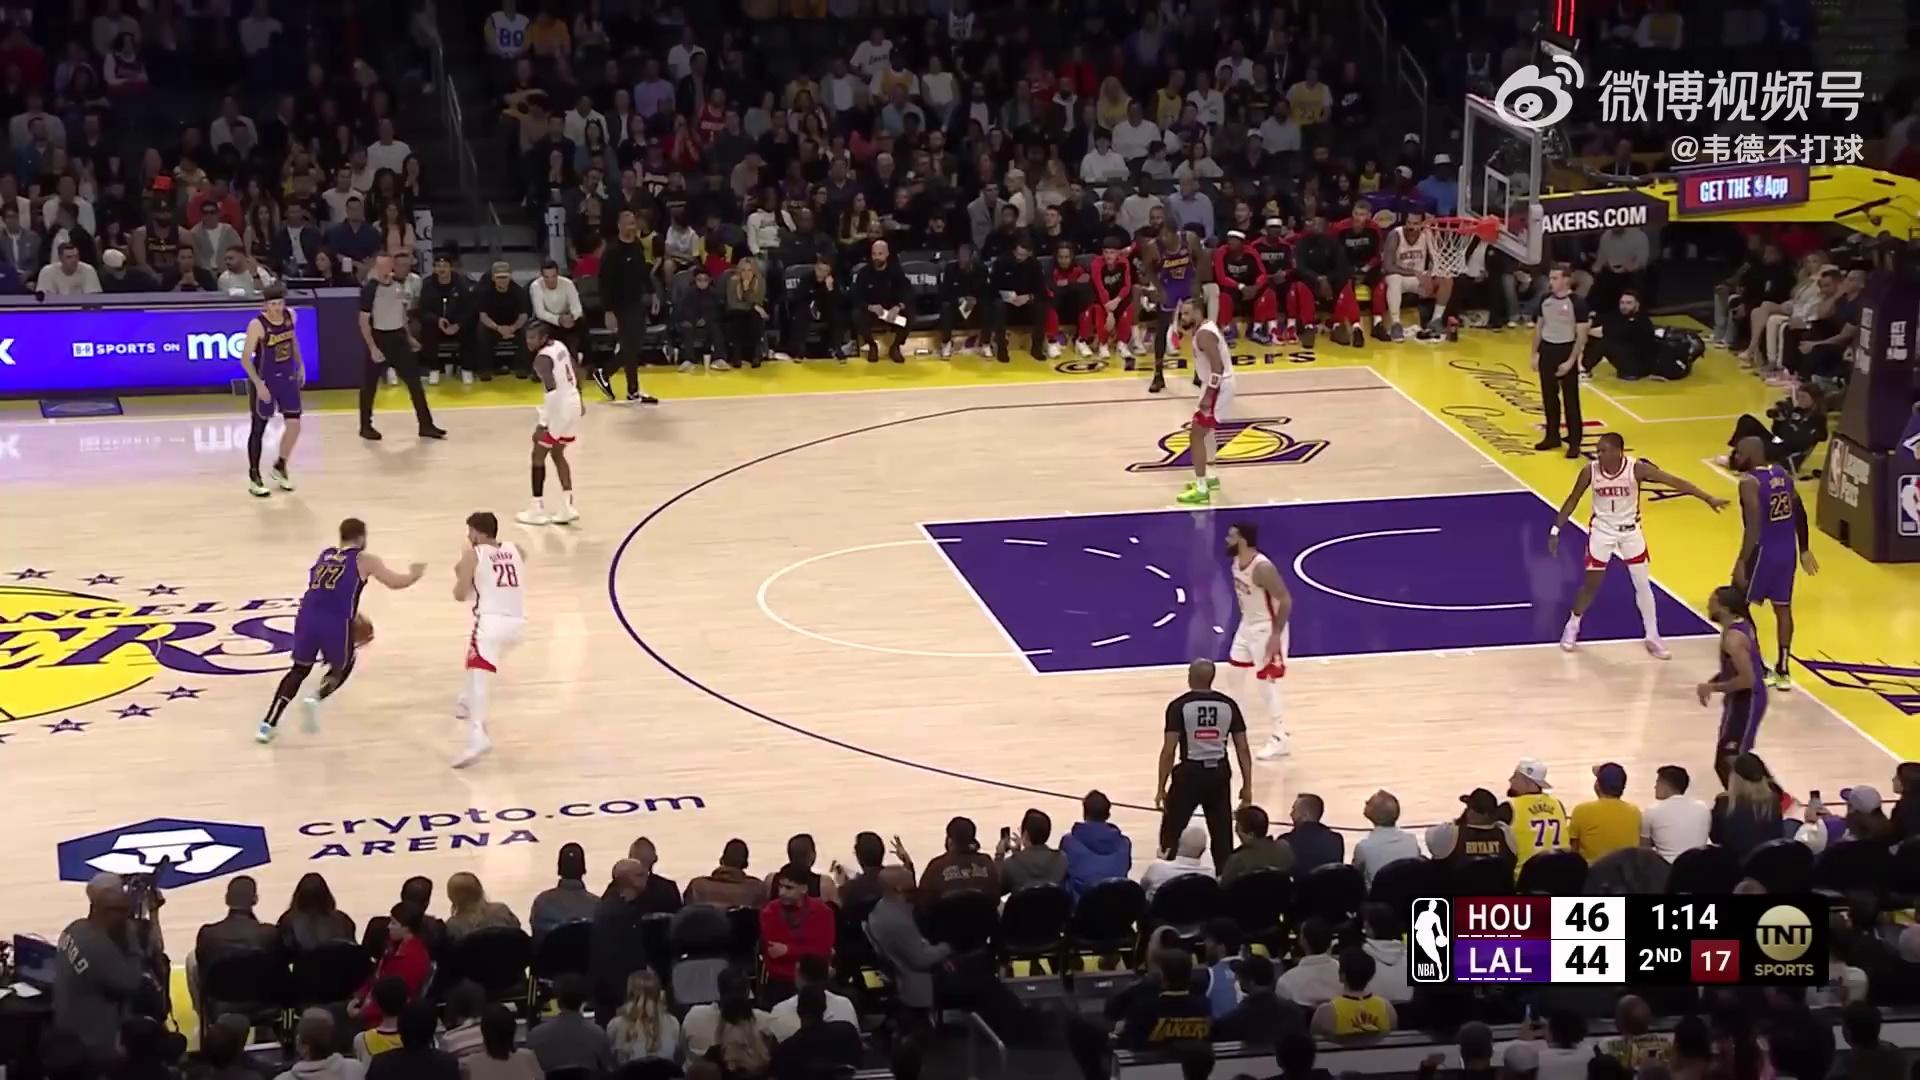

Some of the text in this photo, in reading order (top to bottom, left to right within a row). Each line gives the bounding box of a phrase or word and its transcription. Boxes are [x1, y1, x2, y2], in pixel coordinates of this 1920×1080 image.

[1700, 175, 1788, 202] GET THE App
[1541, 205, 1647, 233] AKERS.COM
[96, 343, 156, 355] SPORTS
[163, 343, 180, 352] ON
[1055, 351, 1317, 374] @Laers
[1769, 491, 1793, 522] 23
[493, 563, 520, 588] 28
[1197, 706, 1218, 727] 23
[299, 795, 706, 836] crypto.com
[308, 830, 539, 860] ARENA
[1531, 819, 1561, 847] 77
[1465, 841, 1500, 854] BRYANT
